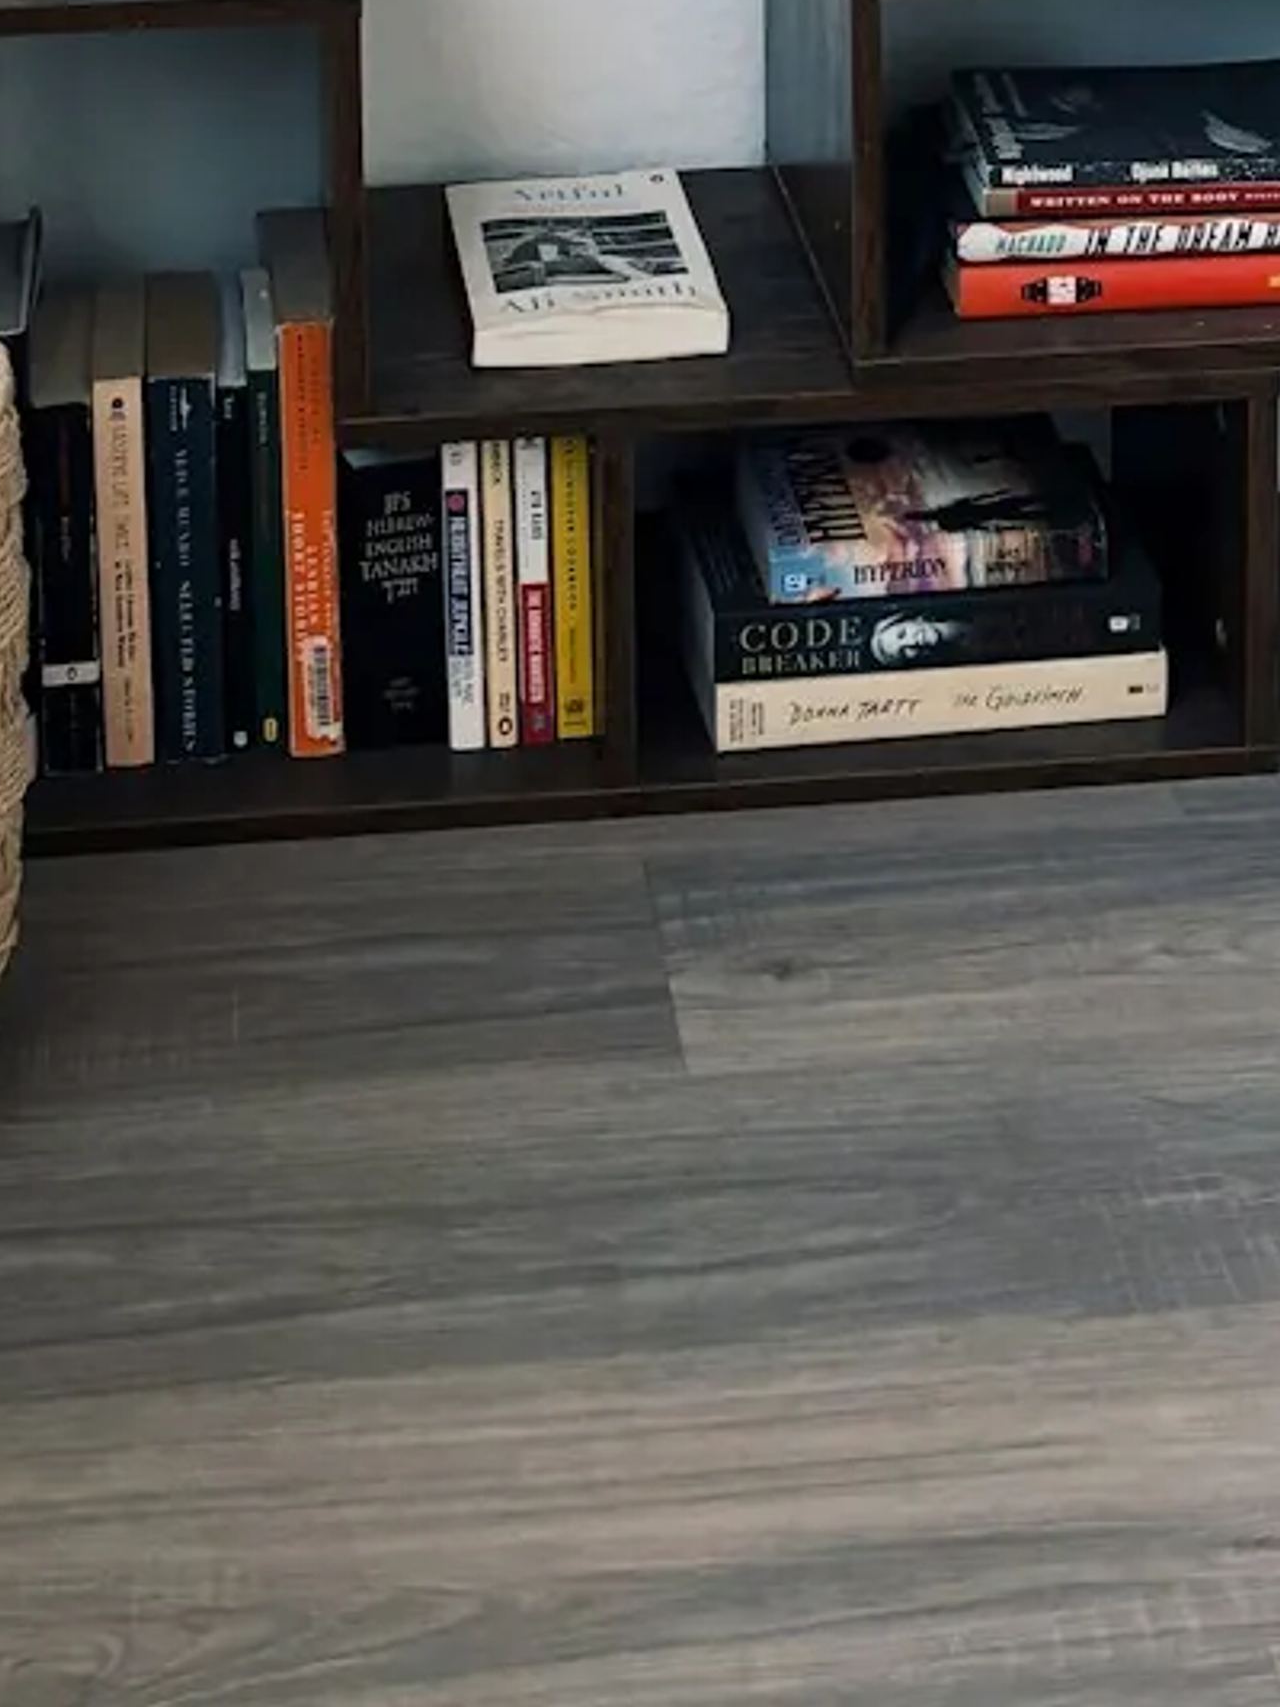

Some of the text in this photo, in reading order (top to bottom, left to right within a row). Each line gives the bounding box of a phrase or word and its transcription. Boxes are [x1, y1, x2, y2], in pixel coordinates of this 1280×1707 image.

[1001, 162, 1073, 185] Nightwood
[1029, 195, 1111, 208] WRITTEN
[1117, 194, 1144, 206] ON
[1150, 193, 1185, 205] THE
[1191, 192, 1239, 204] BODY
[1084, 229, 1111, 255] IN
[1122, 225, 1163, 252] THE
[1176, 222, 1254, 251] DREAM
[364, 532, 433, 559] ENGLISH
[358, 551, 439, 581] TANAKH
[853, 555, 948, 585] HYPERION
[739, 616, 863, 654] CODE
[741, 651, 861, 675] BREAKER
[856, 696, 923, 721] TARTT
